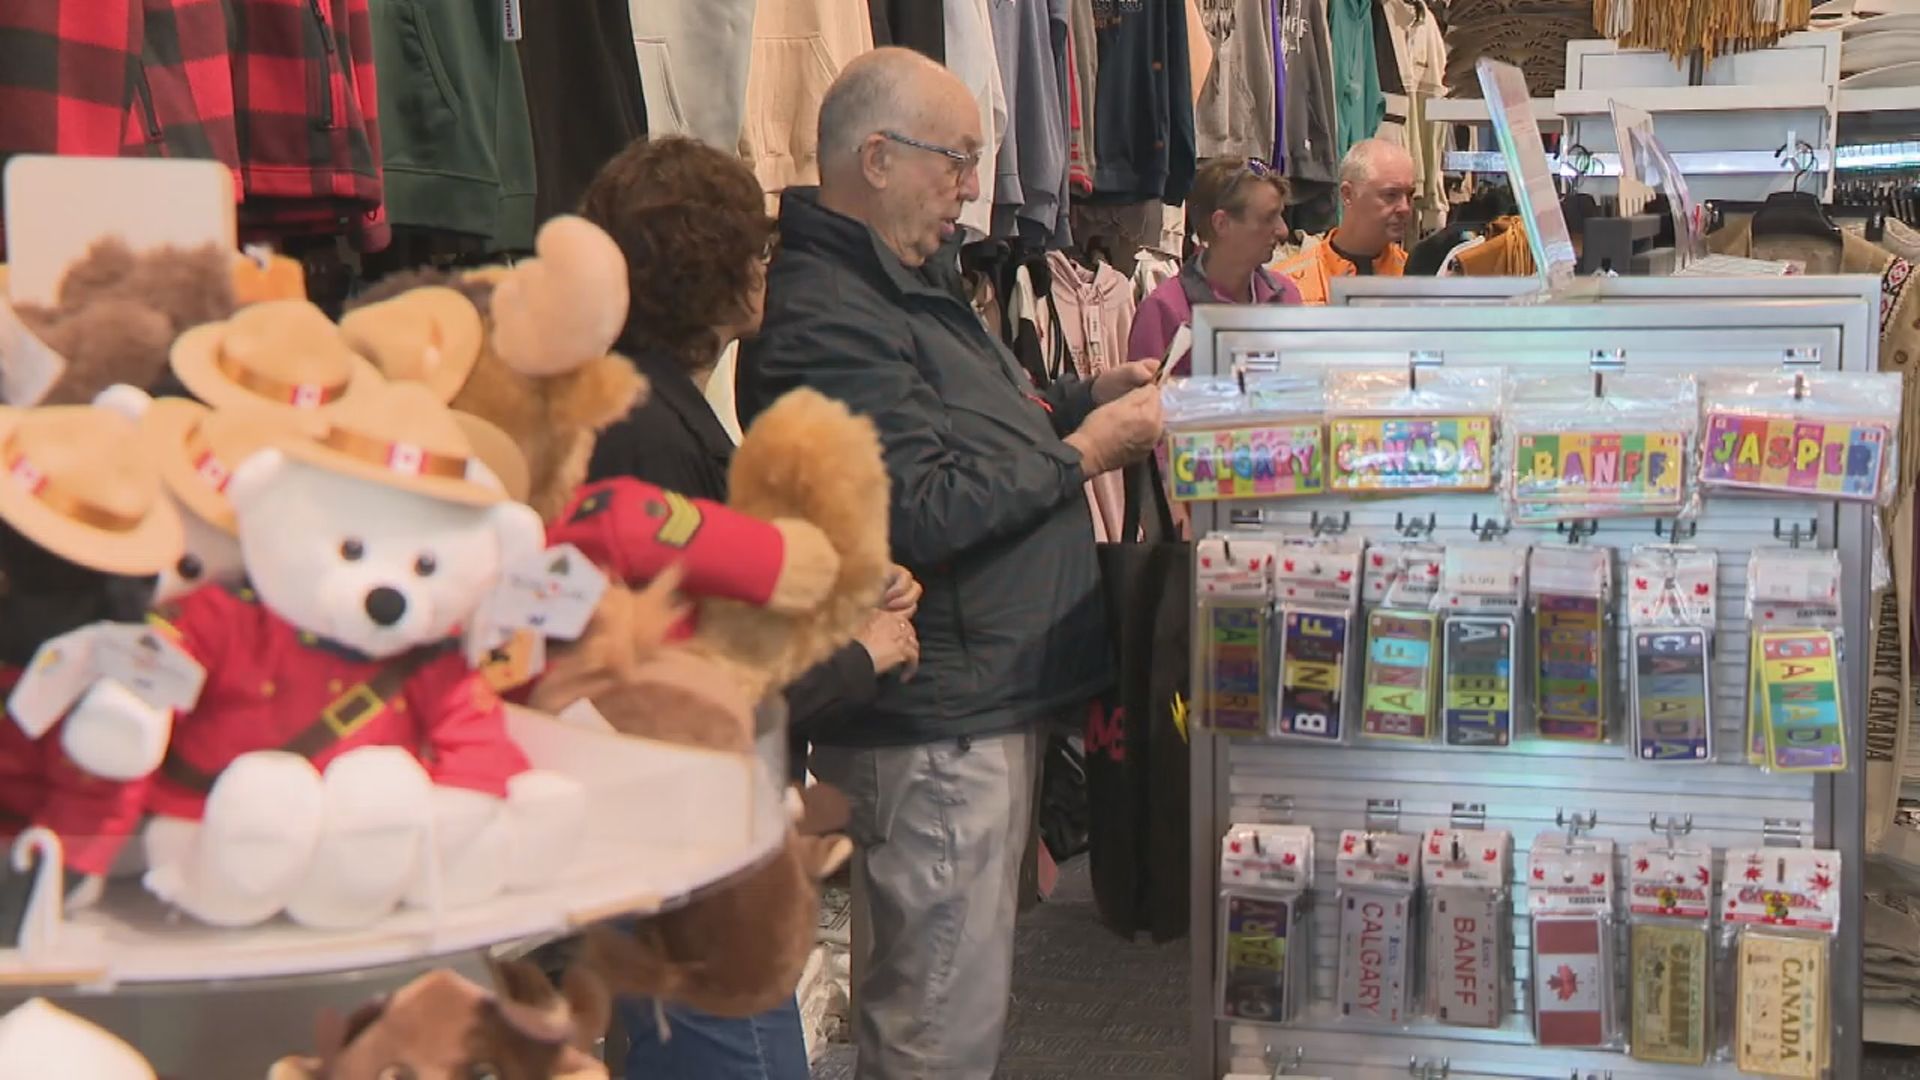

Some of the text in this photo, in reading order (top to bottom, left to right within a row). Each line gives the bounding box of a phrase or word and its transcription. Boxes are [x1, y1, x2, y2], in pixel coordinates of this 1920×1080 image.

[1174, 443, 1315, 483] CALGARY
[1335, 437, 1483, 472] CANADA
[1533, 450, 1668, 486] BANFF
[1712, 431, 1872, 477] JASPER
[1294, 617, 1334, 732] BANFF
[1379, 622, 1417, 731] BANFF
[1778, 640, 1825, 761] CANADA
[1866, 686, 1902, 762] CANADA
[1358, 902, 1385, 1015] CALGARY
[1453, 916, 1478, 1007] BANFF
[1780, 957, 1803, 1061] CANADA
